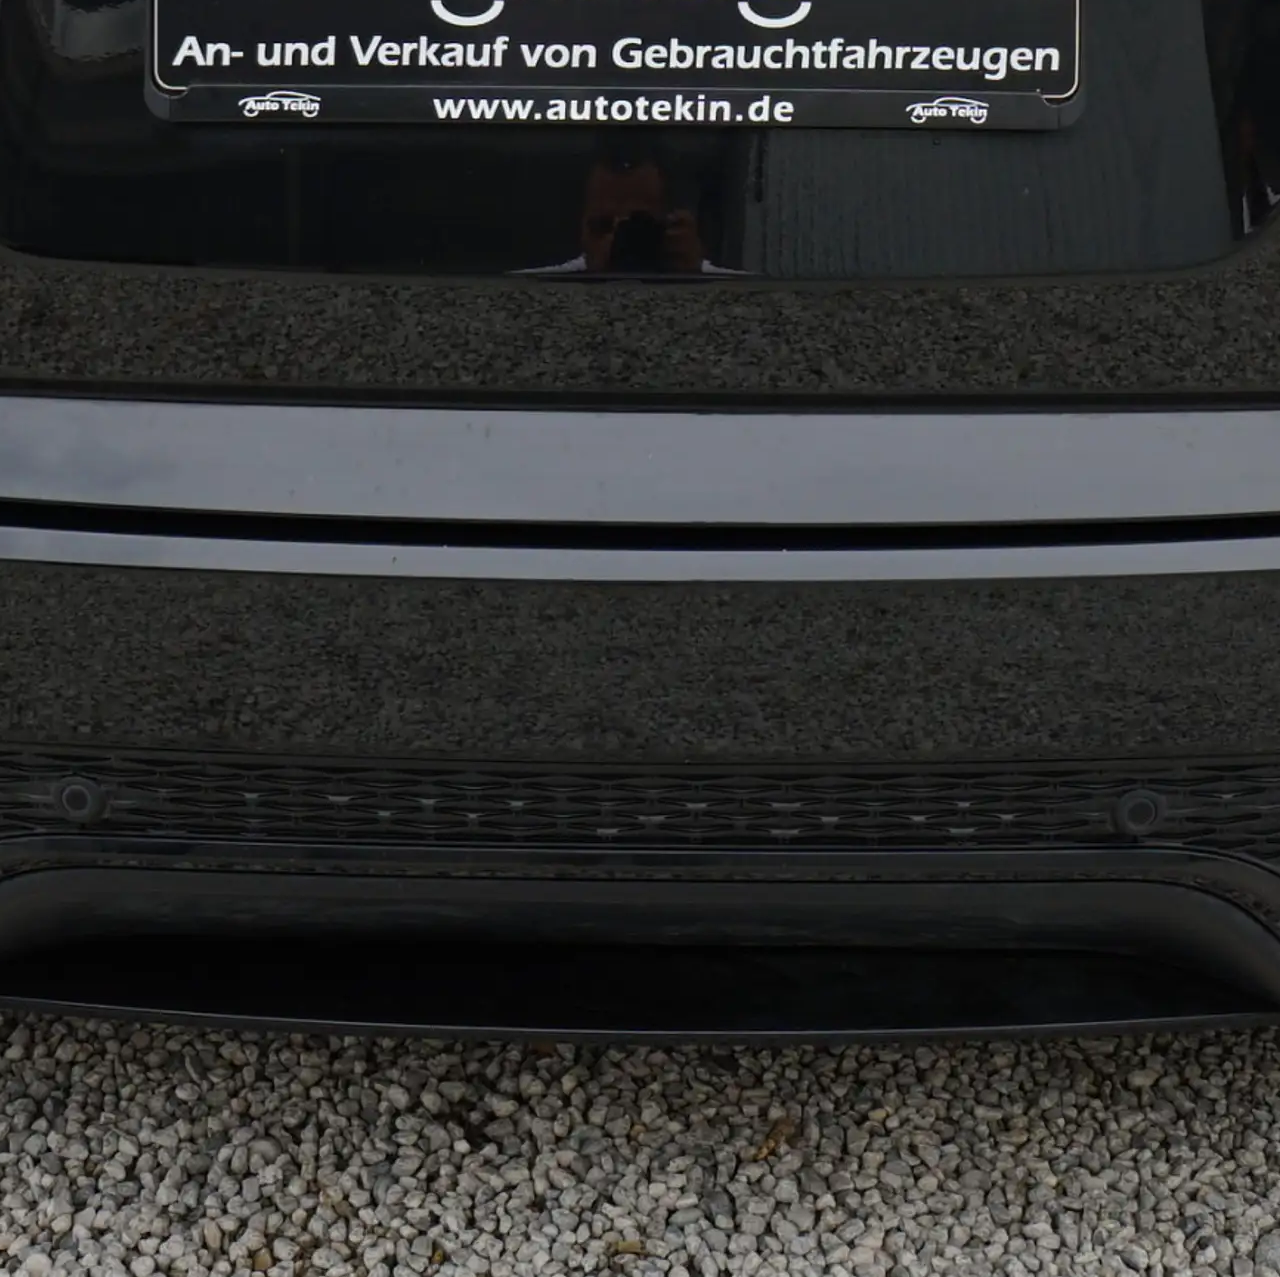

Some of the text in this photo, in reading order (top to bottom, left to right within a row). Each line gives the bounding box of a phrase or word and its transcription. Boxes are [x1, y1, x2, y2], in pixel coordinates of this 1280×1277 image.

[172, 36, 1060, 81] An- und Verkauf von Gebrauchtfahrzeugen
[245, 99, 320, 112] Auto Tekin
[433, 95, 795, 123] www.autotekin.de
[912, 105, 988, 118] Auto Tekin
